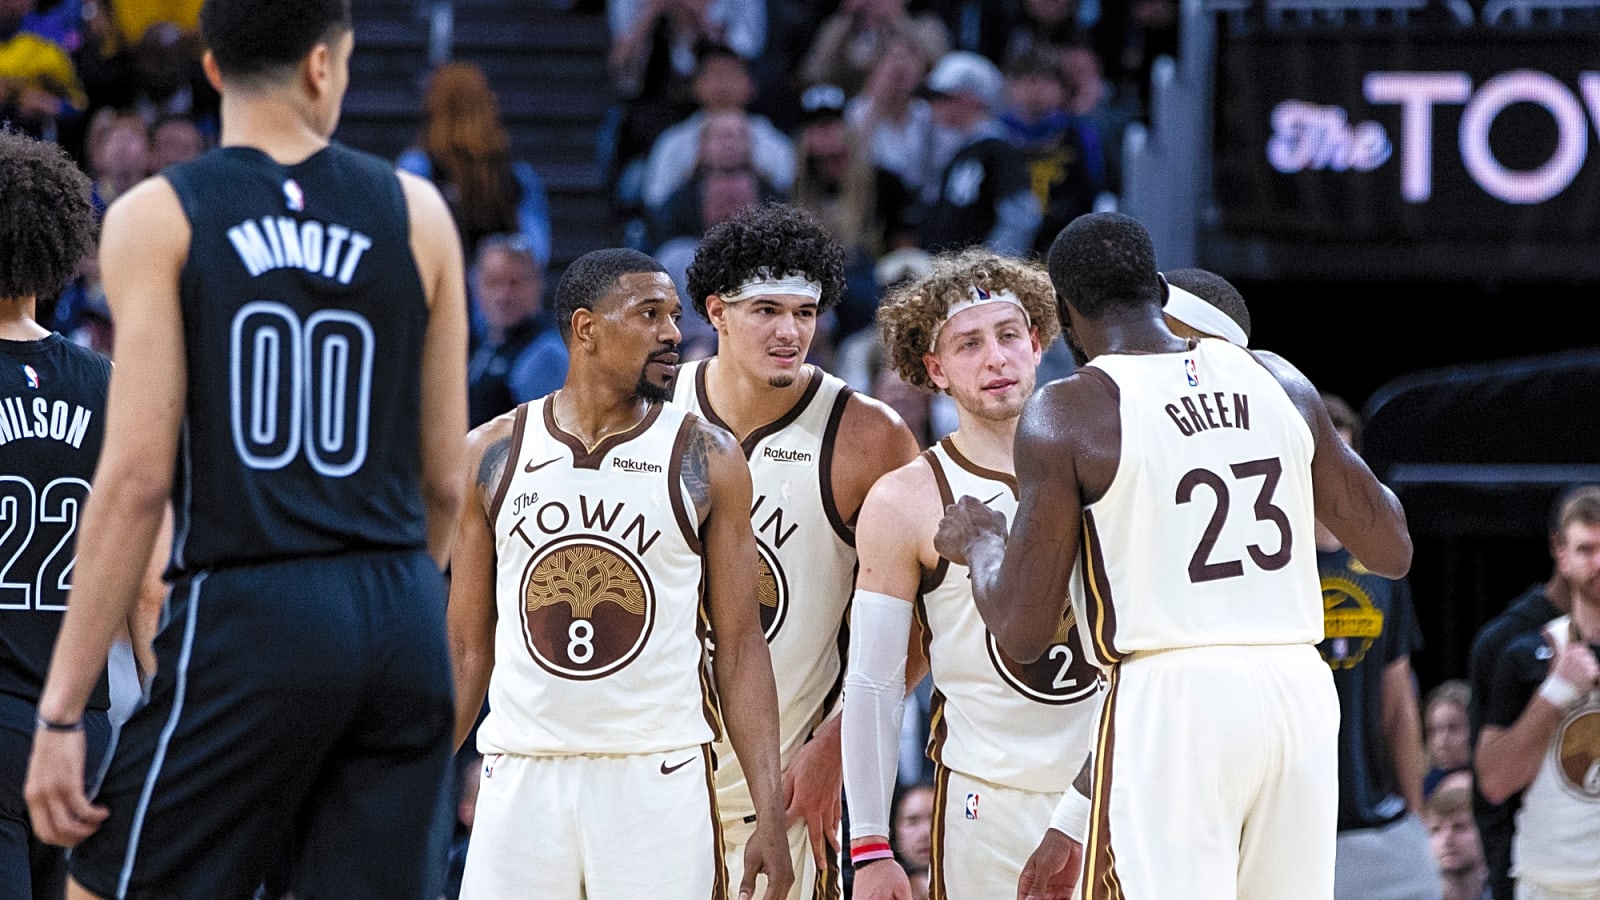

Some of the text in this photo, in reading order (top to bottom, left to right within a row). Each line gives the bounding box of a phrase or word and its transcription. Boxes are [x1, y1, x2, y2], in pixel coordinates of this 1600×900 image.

[227, 216, 372, 284] MINOTT
[230, 301, 375, 477] 00
[1164, 392, 1250, 437] GREEN
[612, 457, 662, 474] Rakuten
[764, 447, 812, 462] Rakuten
[508, 494, 661, 556] TOWN
[512, 491, 539, 516] The
[1175, 457, 1293, 583] 23
[567, 619, 594, 664] 8
[1048, 645, 1077, 689] 2
